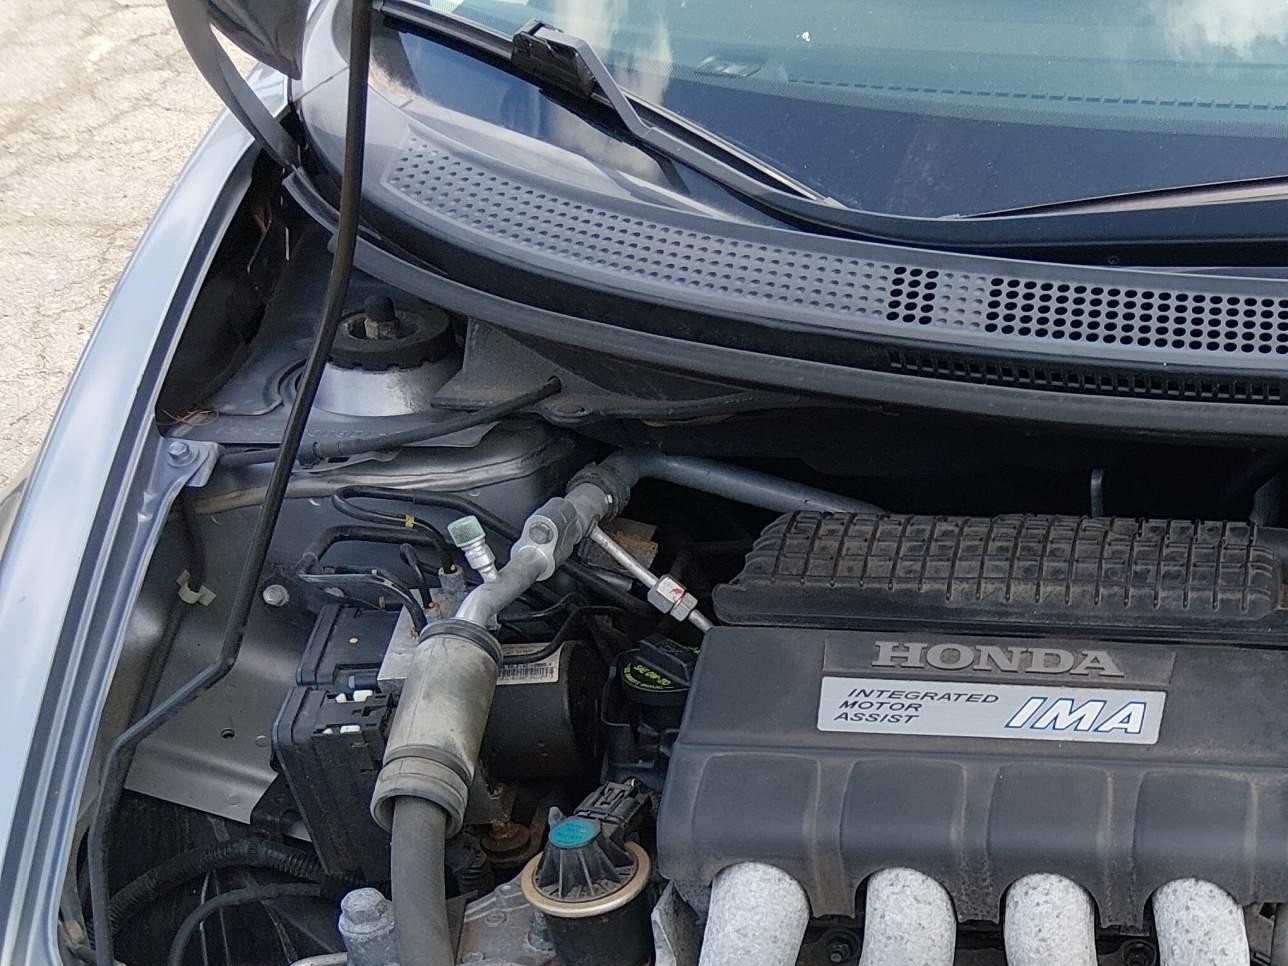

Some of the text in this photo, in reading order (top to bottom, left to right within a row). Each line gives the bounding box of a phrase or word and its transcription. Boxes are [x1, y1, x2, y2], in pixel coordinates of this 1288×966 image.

[872, 640, 1125, 677] HONDA
[848, 688, 1000, 705] INTEGRATED
[838, 700, 924, 713] MOTOR
[1004, 695, 1147, 735] IMA
[834, 711, 920, 725] ASSIST
